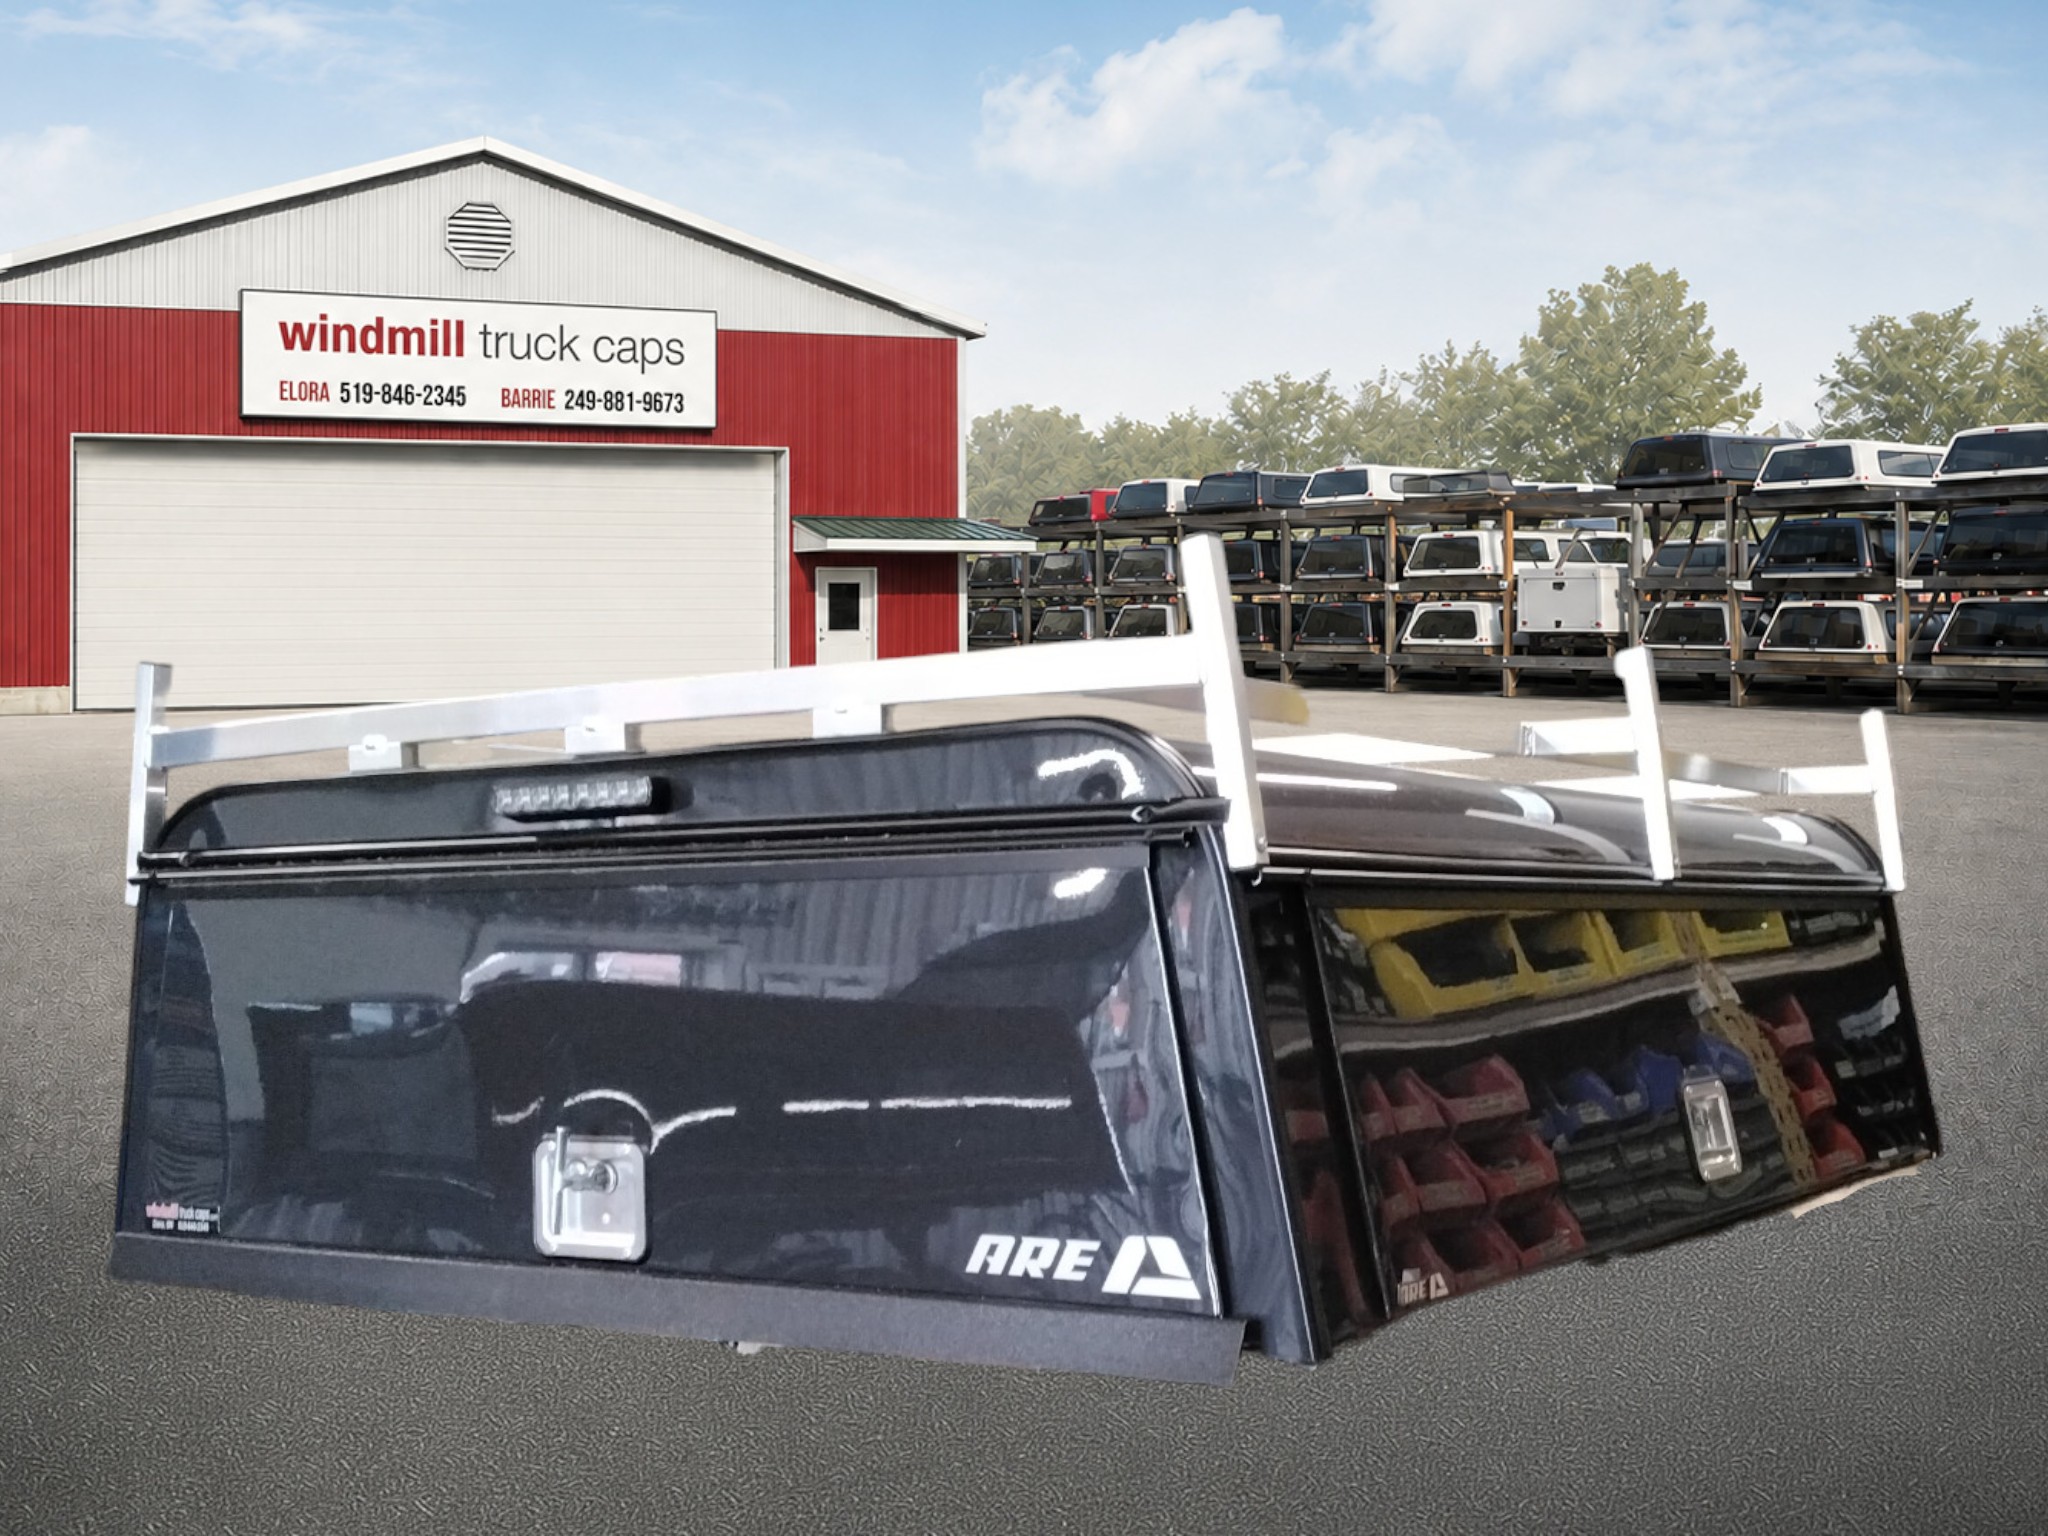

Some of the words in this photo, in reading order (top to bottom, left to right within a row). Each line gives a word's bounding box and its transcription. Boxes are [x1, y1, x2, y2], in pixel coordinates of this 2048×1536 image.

[279, 314, 464, 358] windmill
[479, 324, 581, 362] truck
[593, 335, 685, 374] caps
[279, 381, 330, 402] ELORA
[340, 382, 467, 407] 519-846-2345
[501, 388, 556, 410] BARRIE
[564, 389, 684, 414] 249-881-9673
[965, 1233, 1101, 1281] ARE
